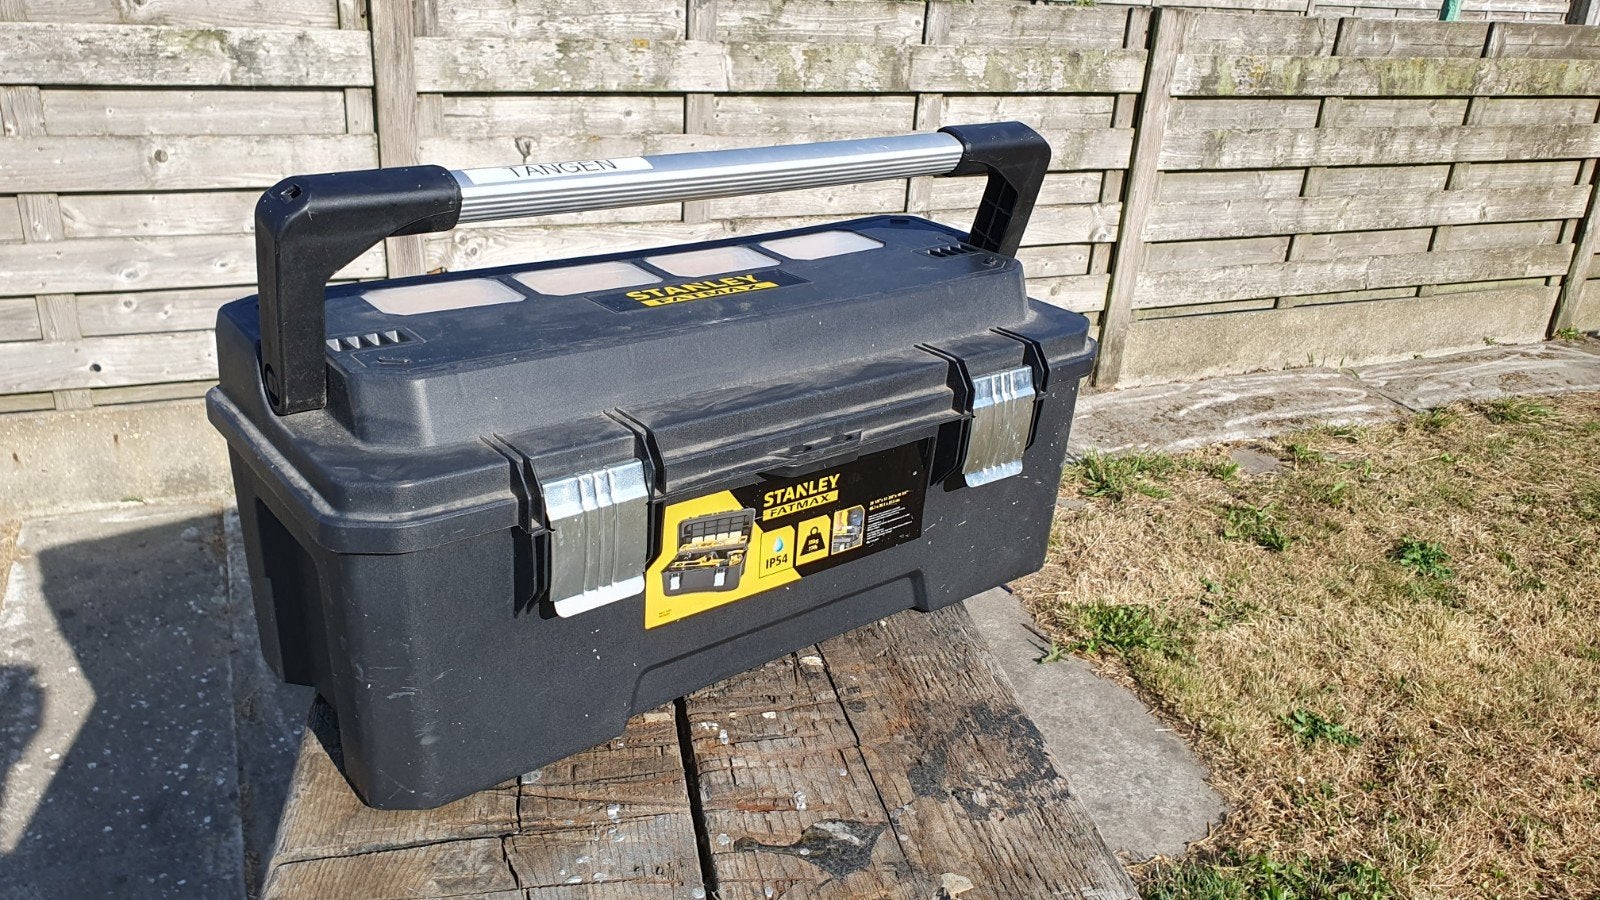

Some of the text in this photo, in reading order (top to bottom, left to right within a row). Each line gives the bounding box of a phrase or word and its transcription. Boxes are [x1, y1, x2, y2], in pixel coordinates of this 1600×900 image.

[504, 159, 618, 178] TANGEN
[625, 274, 759, 301] STANLEY
[656, 283, 758, 304] FATMAX
[763, 473, 840, 508] STANLEY
[770, 493, 830, 517] FATMAX
[765, 553, 788, 569] IP54
